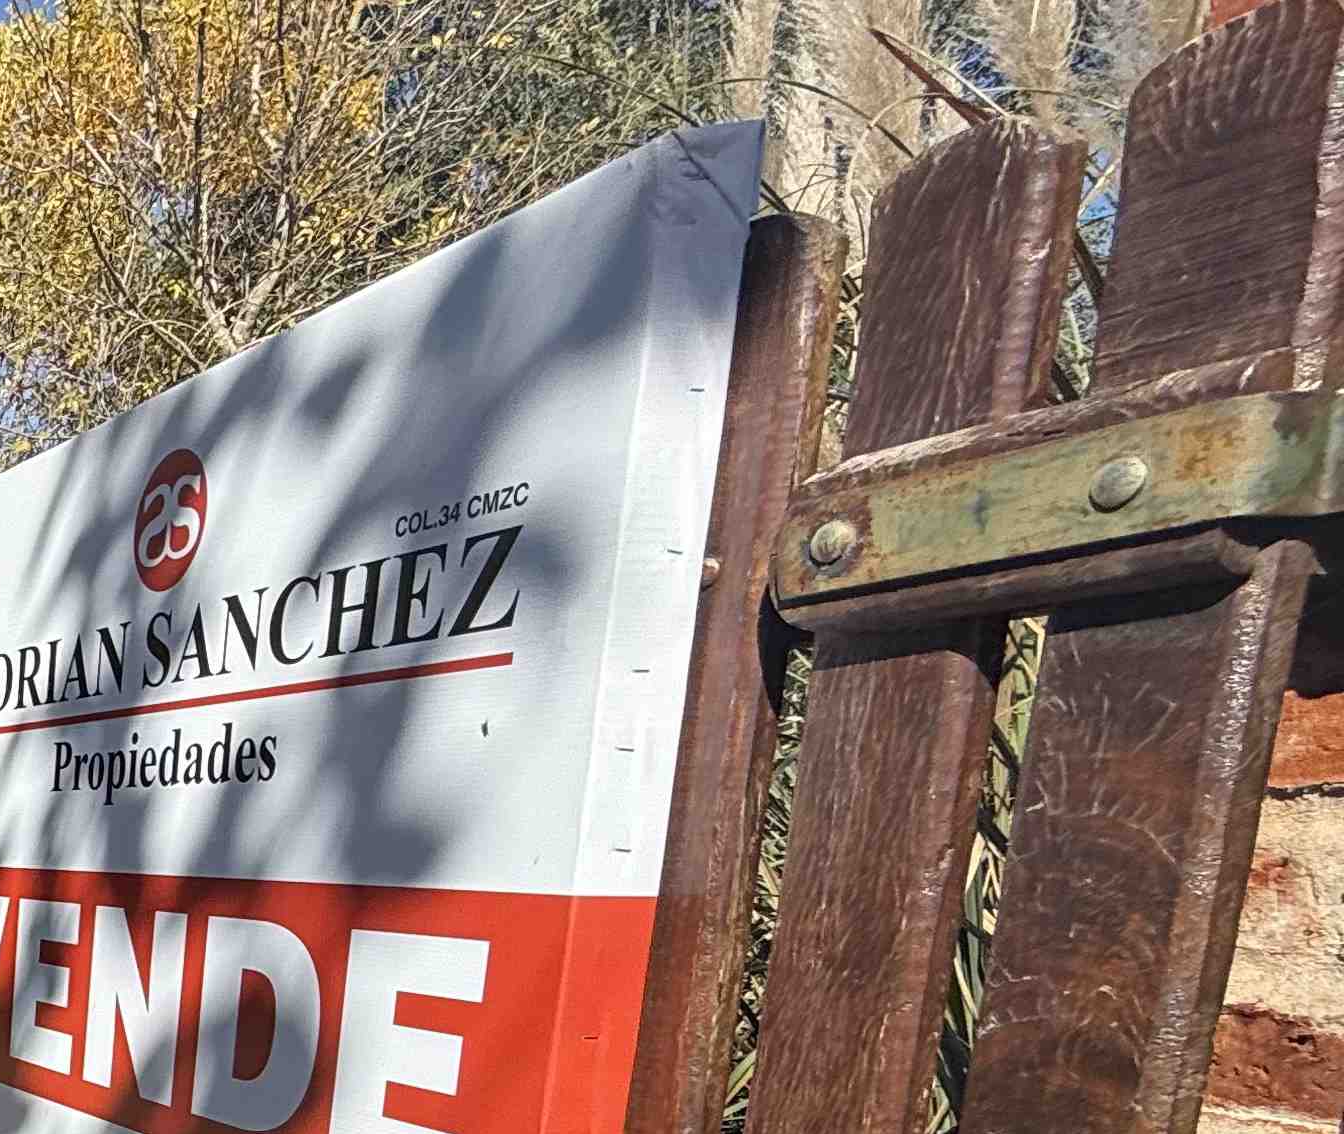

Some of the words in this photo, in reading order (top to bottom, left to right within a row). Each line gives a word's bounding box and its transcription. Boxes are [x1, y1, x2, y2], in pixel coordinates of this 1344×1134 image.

[395, 501, 462, 538] COL.34
[467, 482, 529, 518] CMZC
[141, 524, 524, 690] SANCHEZ
[50, 722, 278, 805] Propiedades
